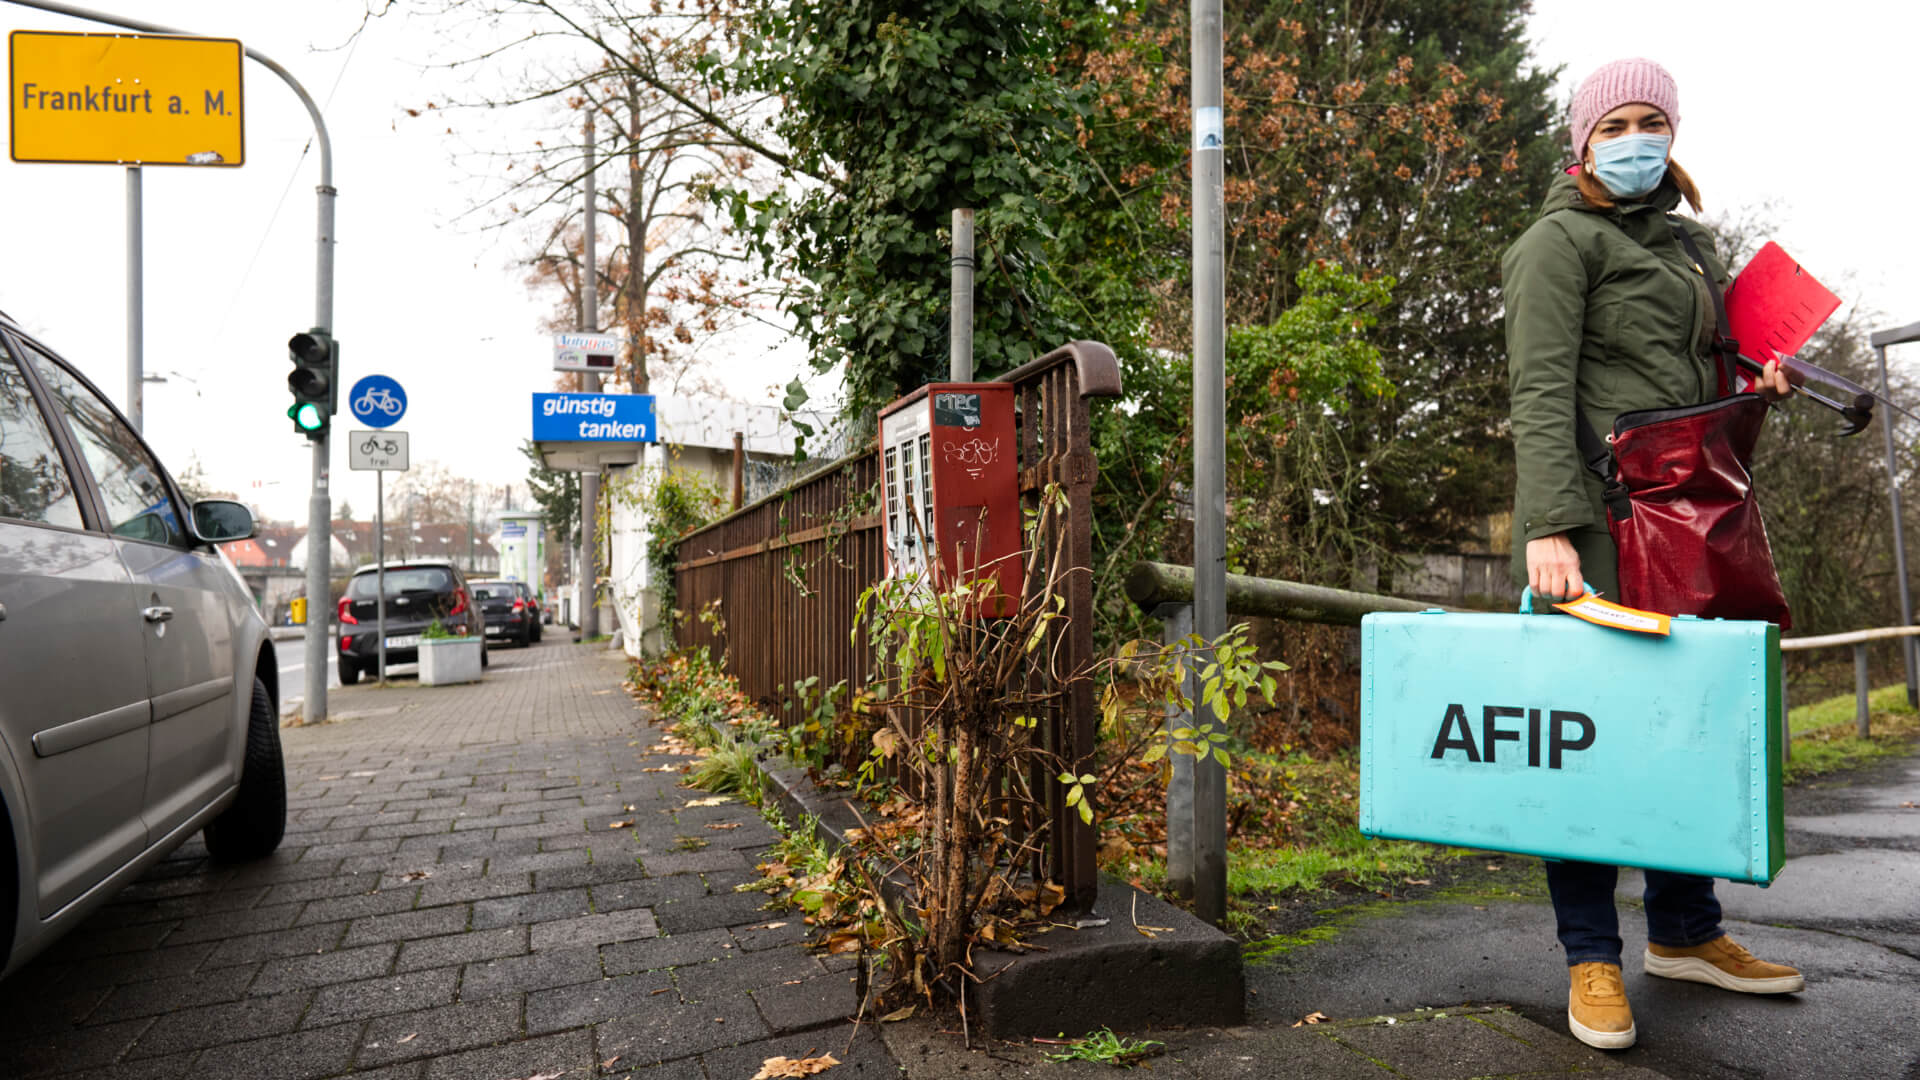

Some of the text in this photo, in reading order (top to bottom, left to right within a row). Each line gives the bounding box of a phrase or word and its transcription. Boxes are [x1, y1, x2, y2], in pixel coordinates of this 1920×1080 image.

[22, 83, 232, 116] Frankfurt a. M.
[543, 396, 616, 417] günstig
[579, 421, 646, 438] tanken
[370, 457, 389, 465] frei
[1431, 704, 1597, 769] AFIP
